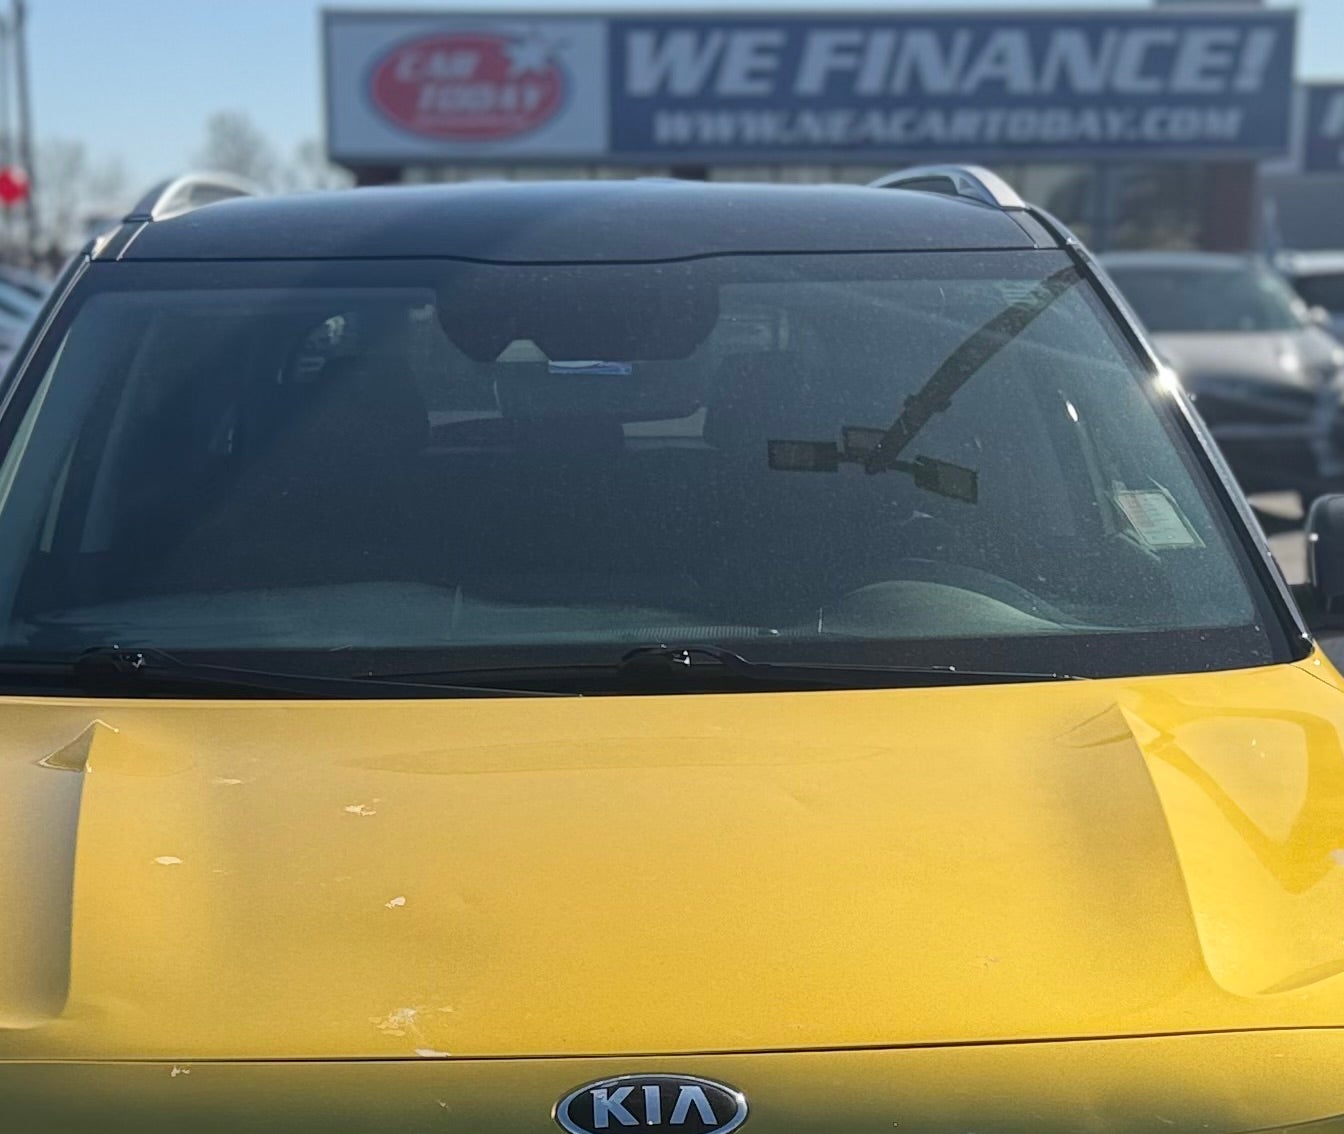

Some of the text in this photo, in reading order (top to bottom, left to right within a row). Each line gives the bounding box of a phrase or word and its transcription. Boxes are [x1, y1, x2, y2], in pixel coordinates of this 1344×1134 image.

[393, 49, 483, 83] CAR
[627, 26, 1275, 96] WE FINANCE!
[416, 81, 550, 115] TODAY
[590, 1084, 719, 1129] KIA
